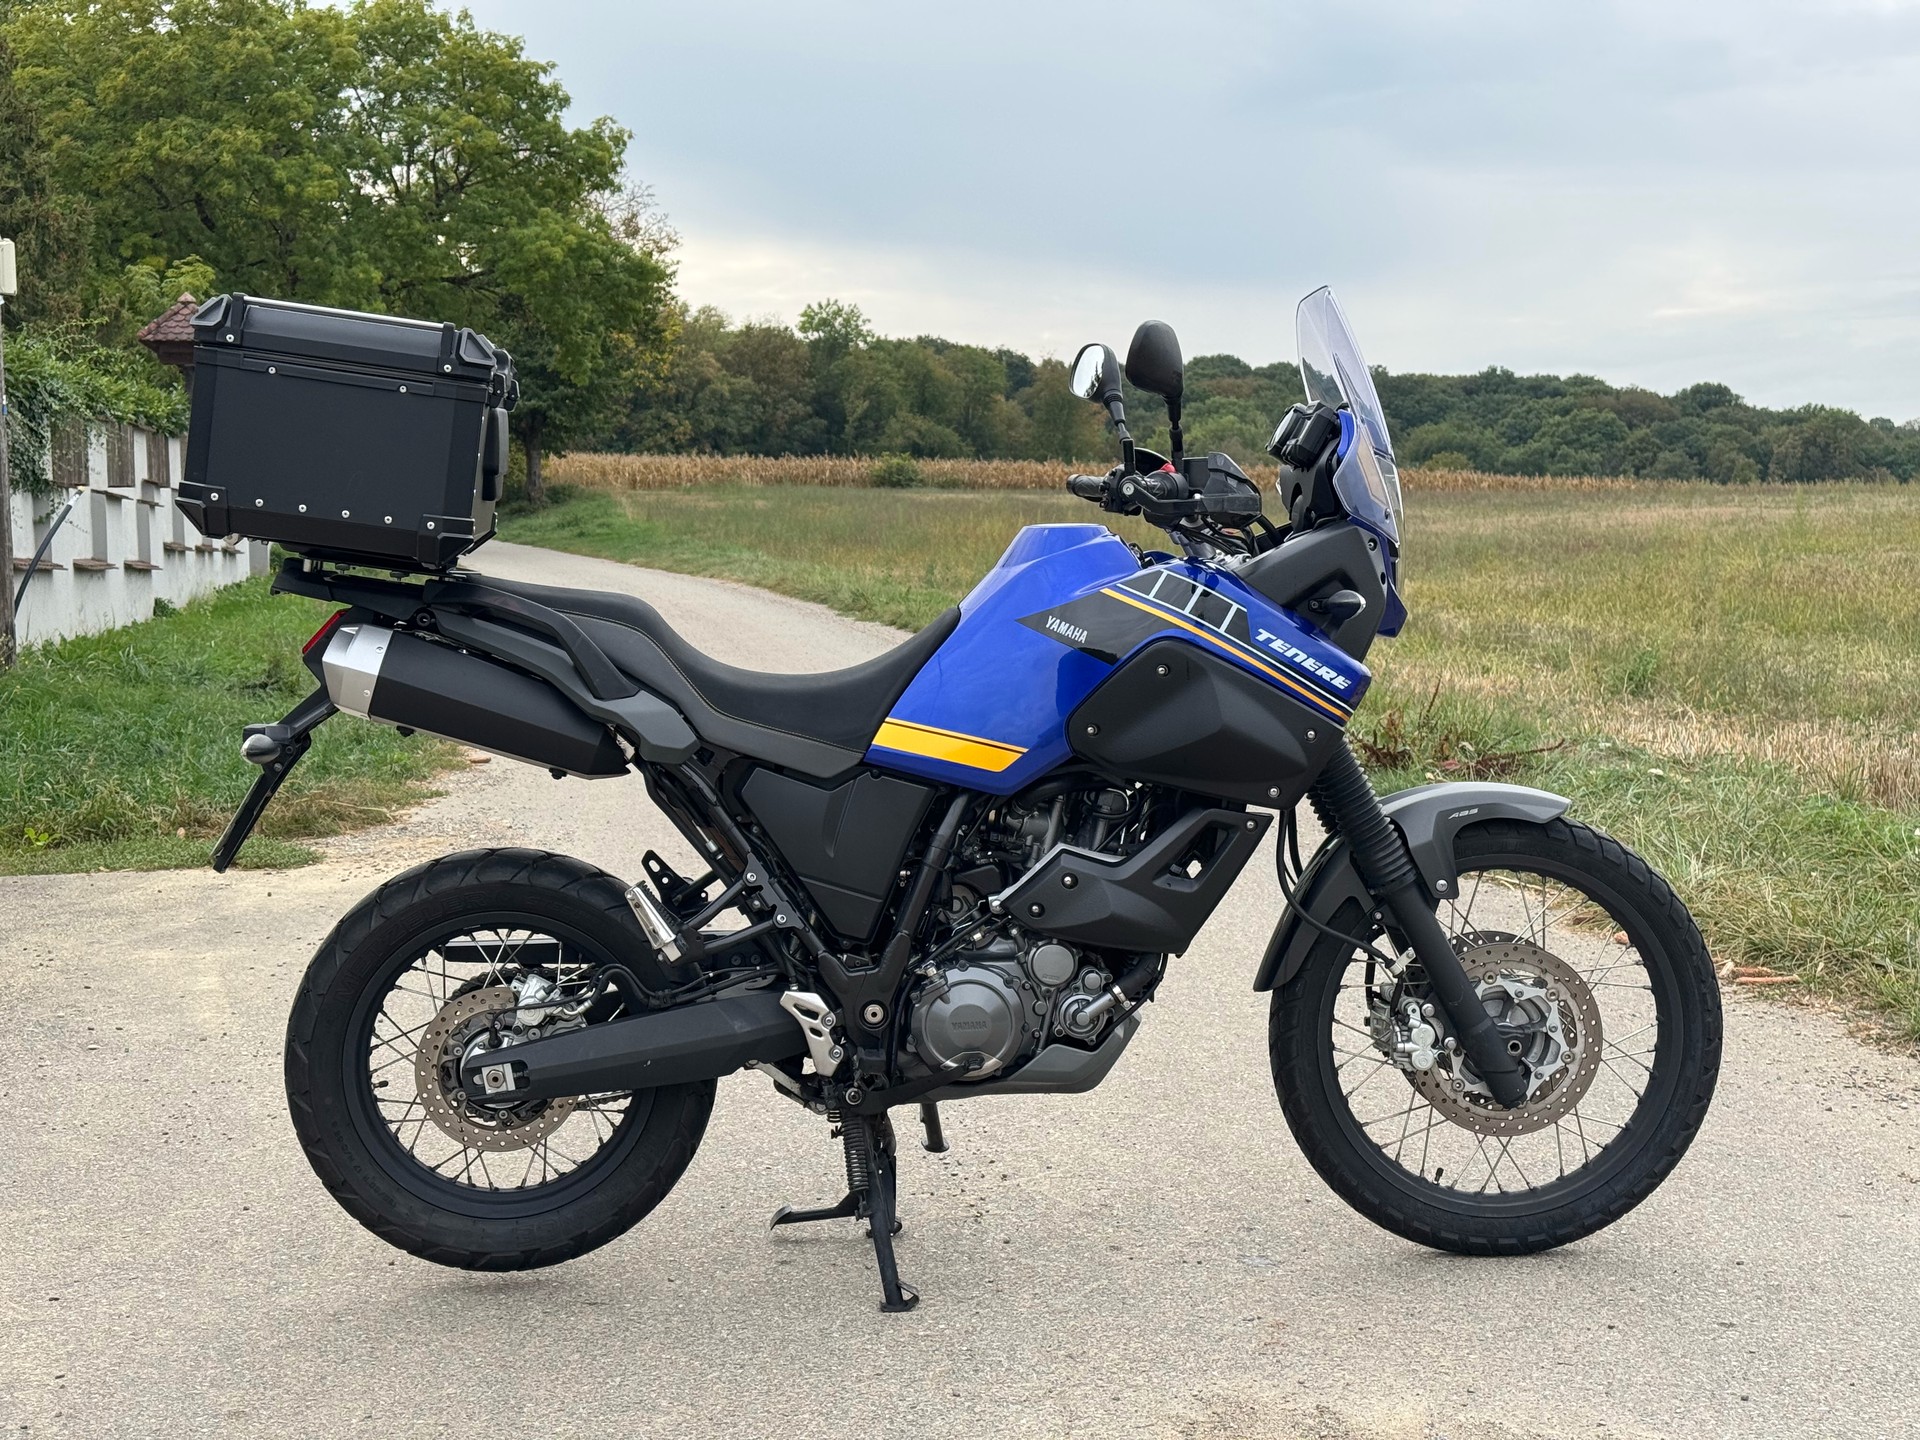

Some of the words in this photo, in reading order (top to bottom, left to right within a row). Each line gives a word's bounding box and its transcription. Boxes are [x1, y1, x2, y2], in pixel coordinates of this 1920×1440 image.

[1045, 615, 1088, 643] YAMAHA
[1255, 628, 1352, 690] TENERE
[1448, 807, 1478, 819] ABS
[334, 887, 489, 1004] METZELER
[951, 1020, 988, 1031] YAMAHA
